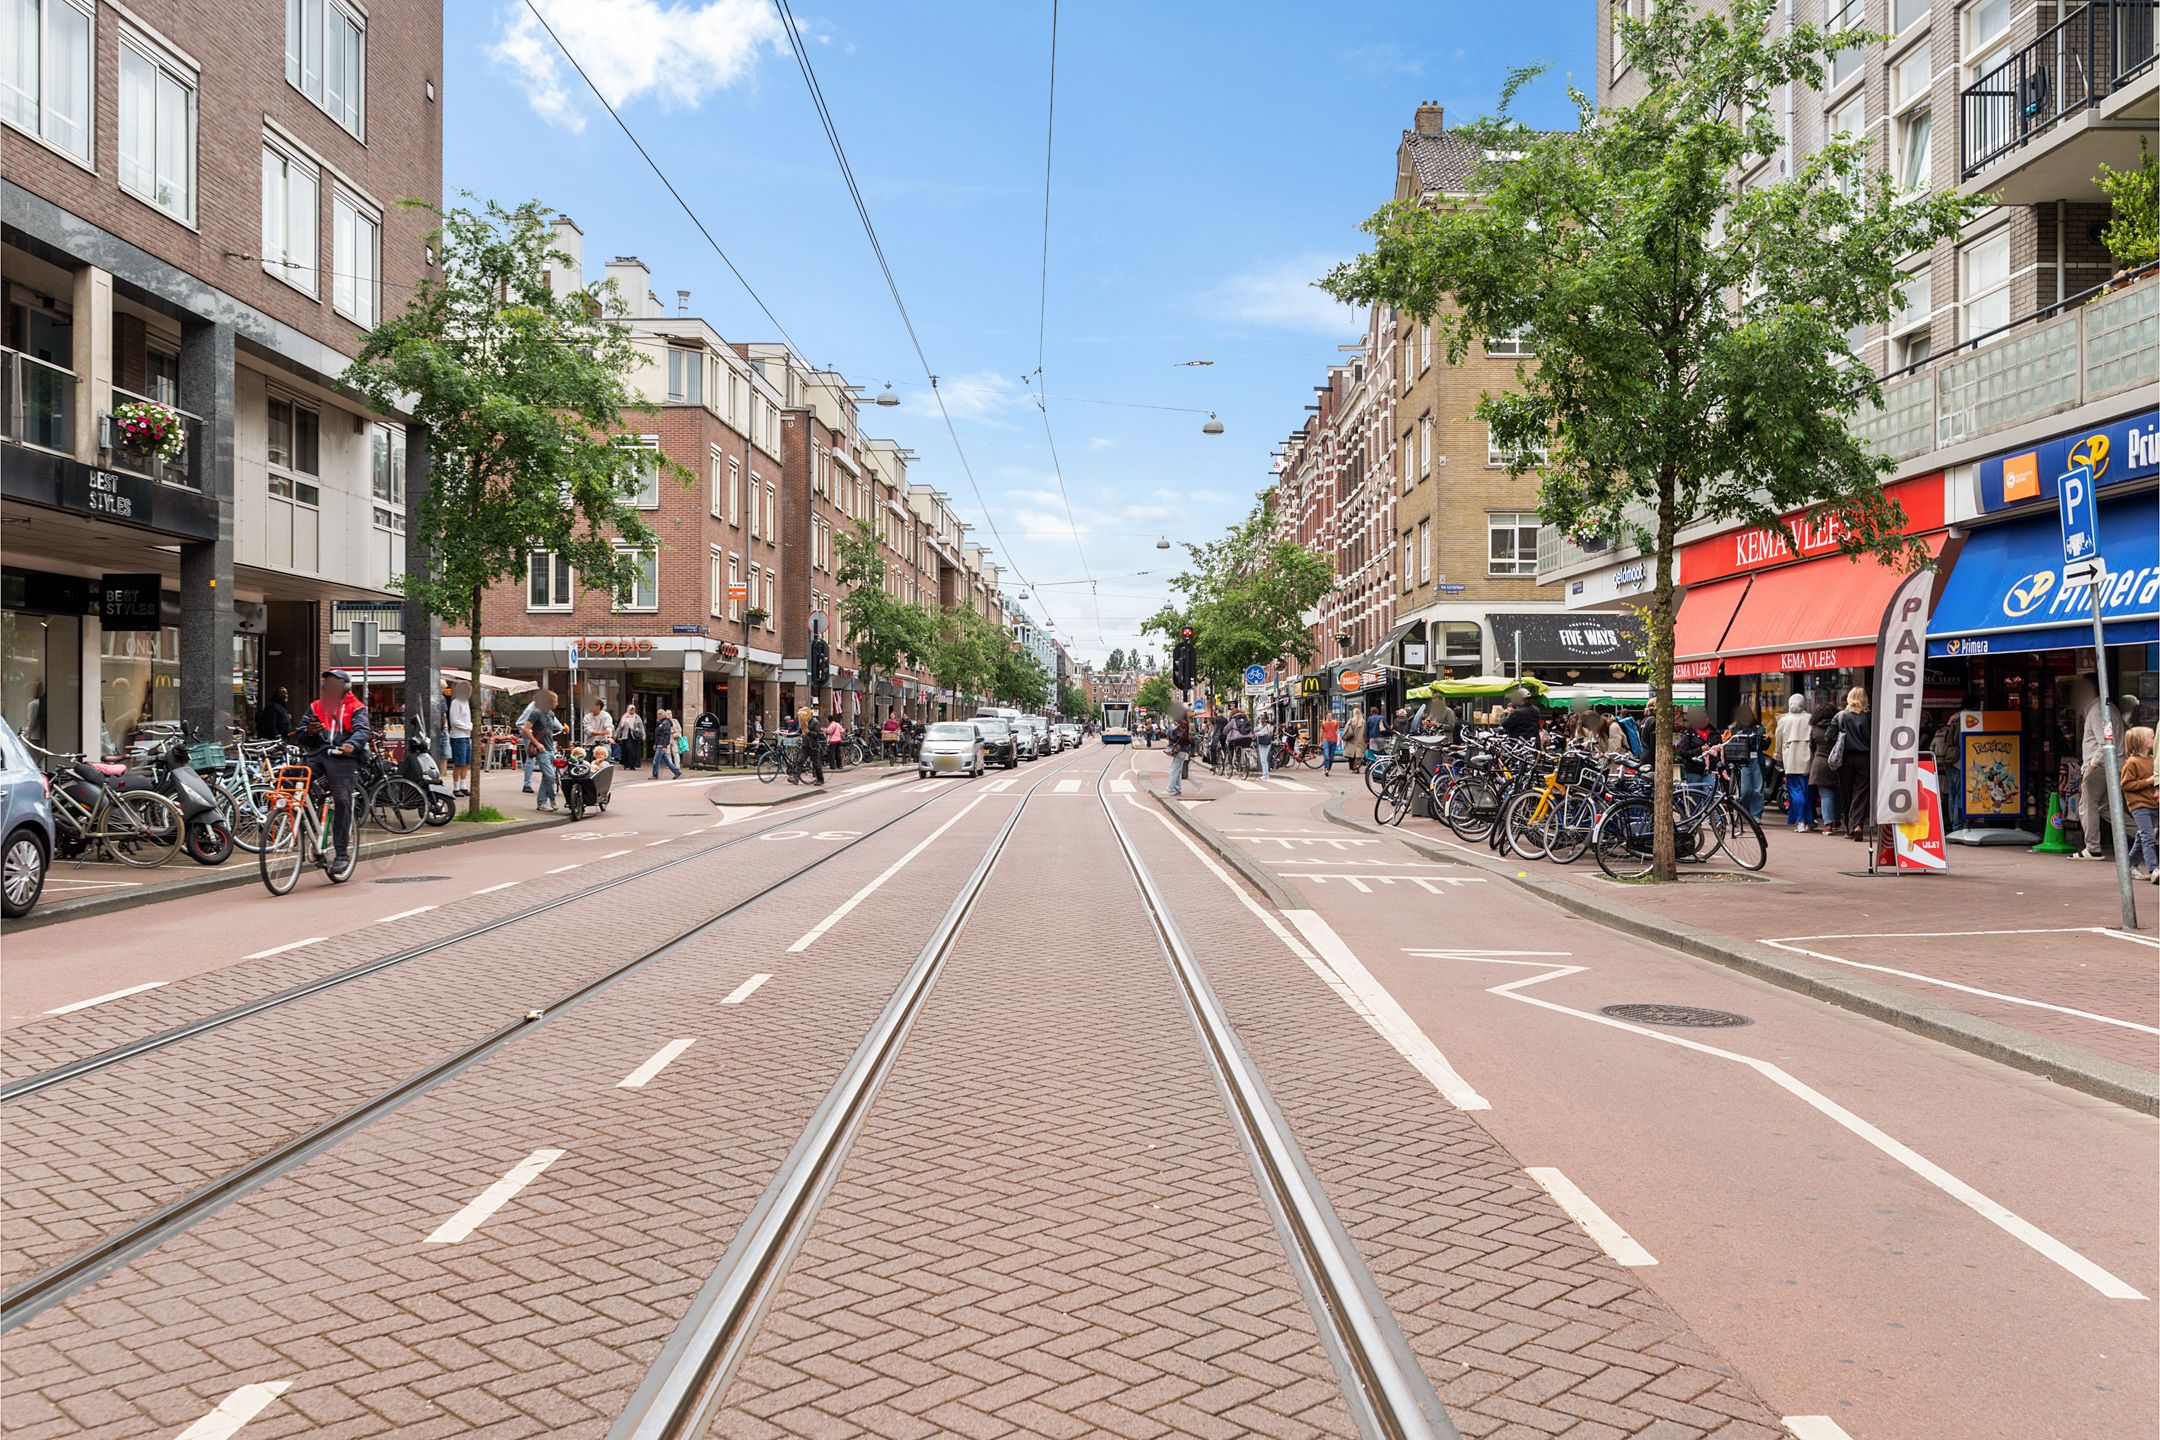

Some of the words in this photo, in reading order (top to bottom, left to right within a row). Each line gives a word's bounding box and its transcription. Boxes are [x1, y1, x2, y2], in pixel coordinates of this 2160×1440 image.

[89, 470, 119, 493] BEST
[89, 490, 132, 517] STYLES
[1736, 528, 1787, 566] KEMA
[1613, 563, 1645, 589] geldmaat
[106, 590, 140, 602] BEST
[106, 603, 156, 615] STYLES
[126, 638, 160, 656] ONLY
[573, 635, 653, 656] doppio
[1559, 629, 1584, 646] FIVE
[1961, 638, 1989, 654] Primera
[1781, 652, 1806, 669] KEMA
[1807, 649, 1837, 668] VLEES
[1673, 665, 1691, 679] KEMA
[1691, 661, 1711, 676] VLEES
[1888, 597, 1922, 814] PASFOTO
